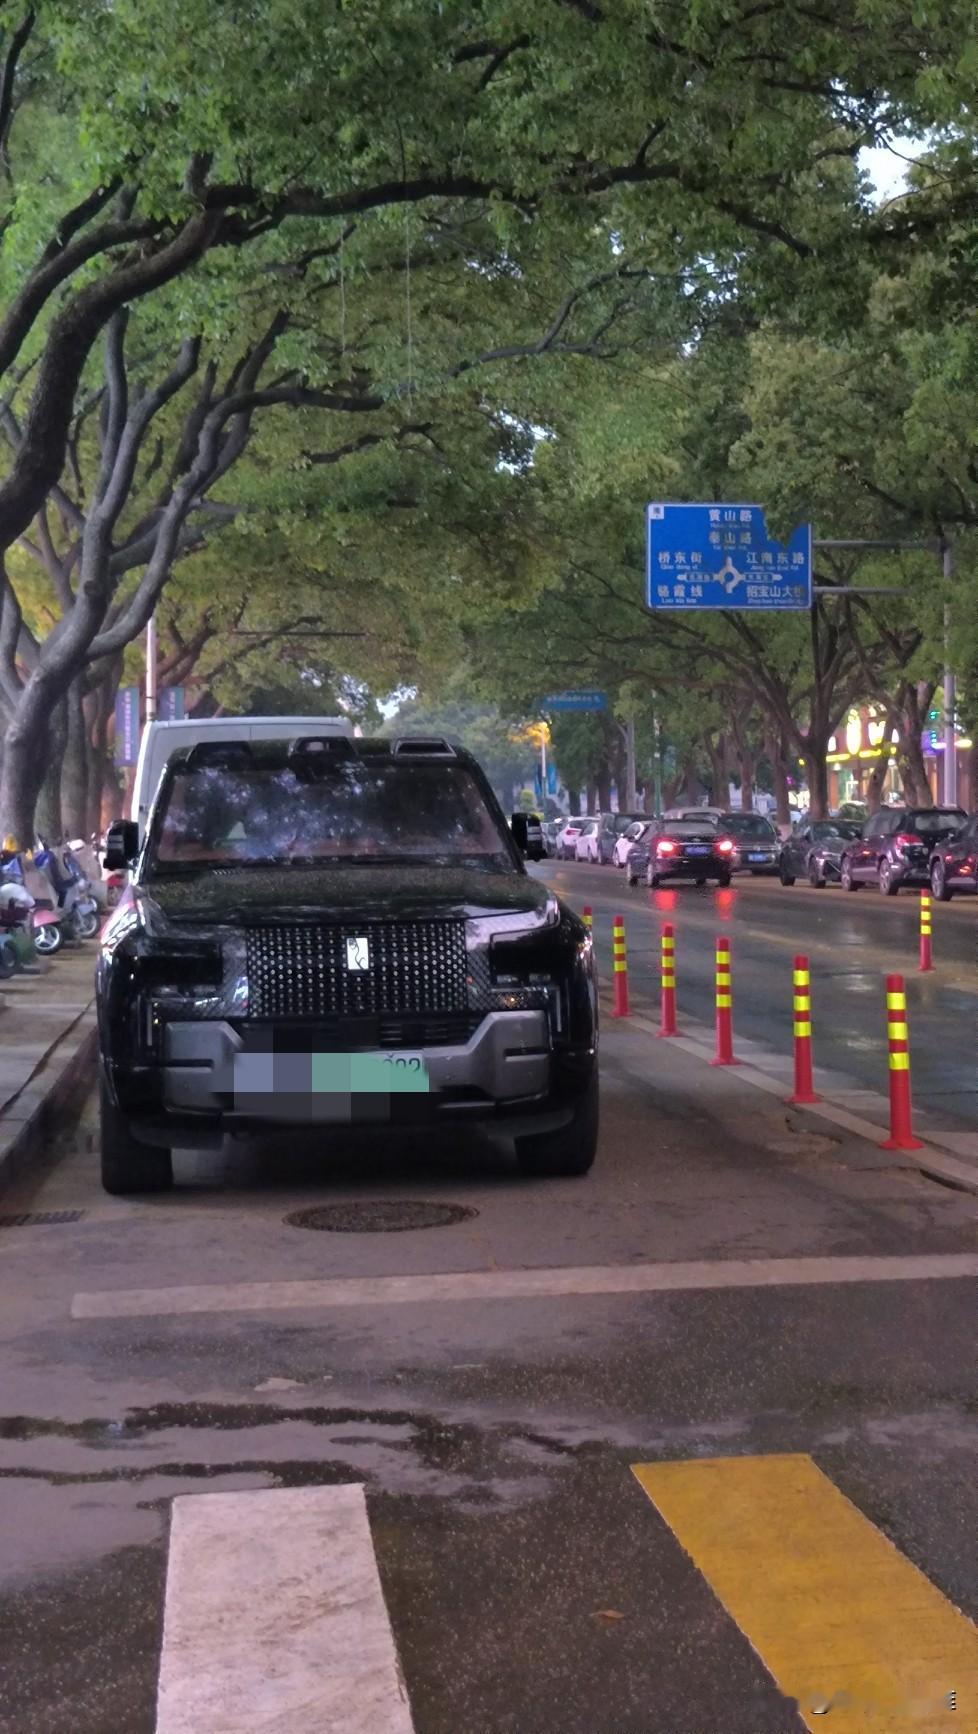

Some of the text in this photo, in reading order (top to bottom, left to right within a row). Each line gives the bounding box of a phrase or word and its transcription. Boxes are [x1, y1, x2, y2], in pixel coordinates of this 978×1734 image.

[709, 509, 752, 522] 黄山路
[658, 552, 702, 564] 桥东街
[746, 552, 804, 565] 江南东路
